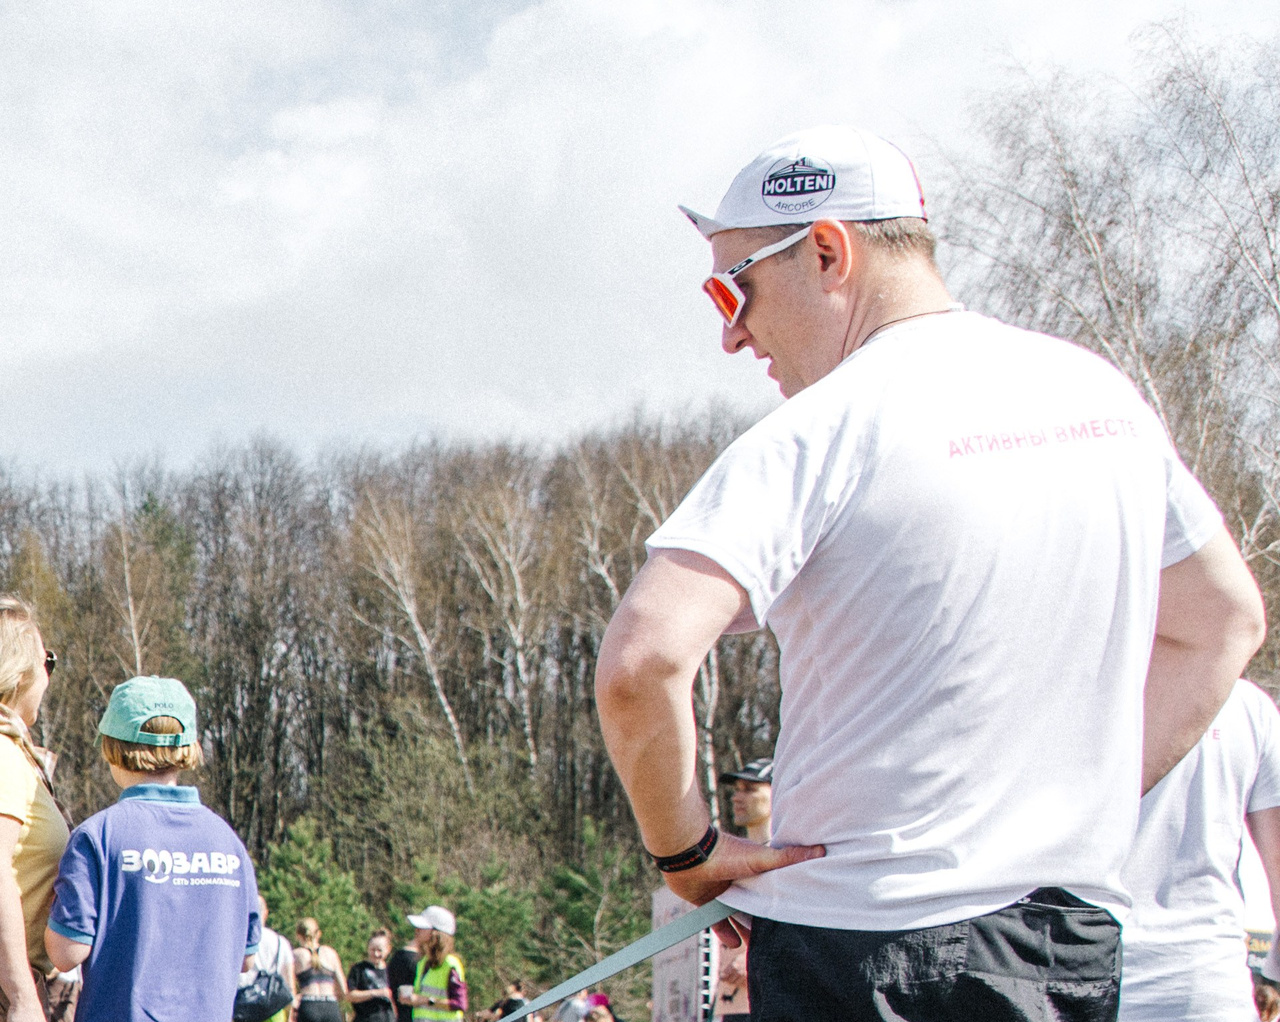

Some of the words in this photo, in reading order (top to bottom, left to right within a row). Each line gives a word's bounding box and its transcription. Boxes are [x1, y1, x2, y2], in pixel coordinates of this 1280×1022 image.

[763, 175, 834, 195] MOLTENI
[775, 199, 816, 212] ARCORE
[949, 430, 1048, 459] АКТИВНЫ
[172, 877, 189, 886] СЕТЬ
